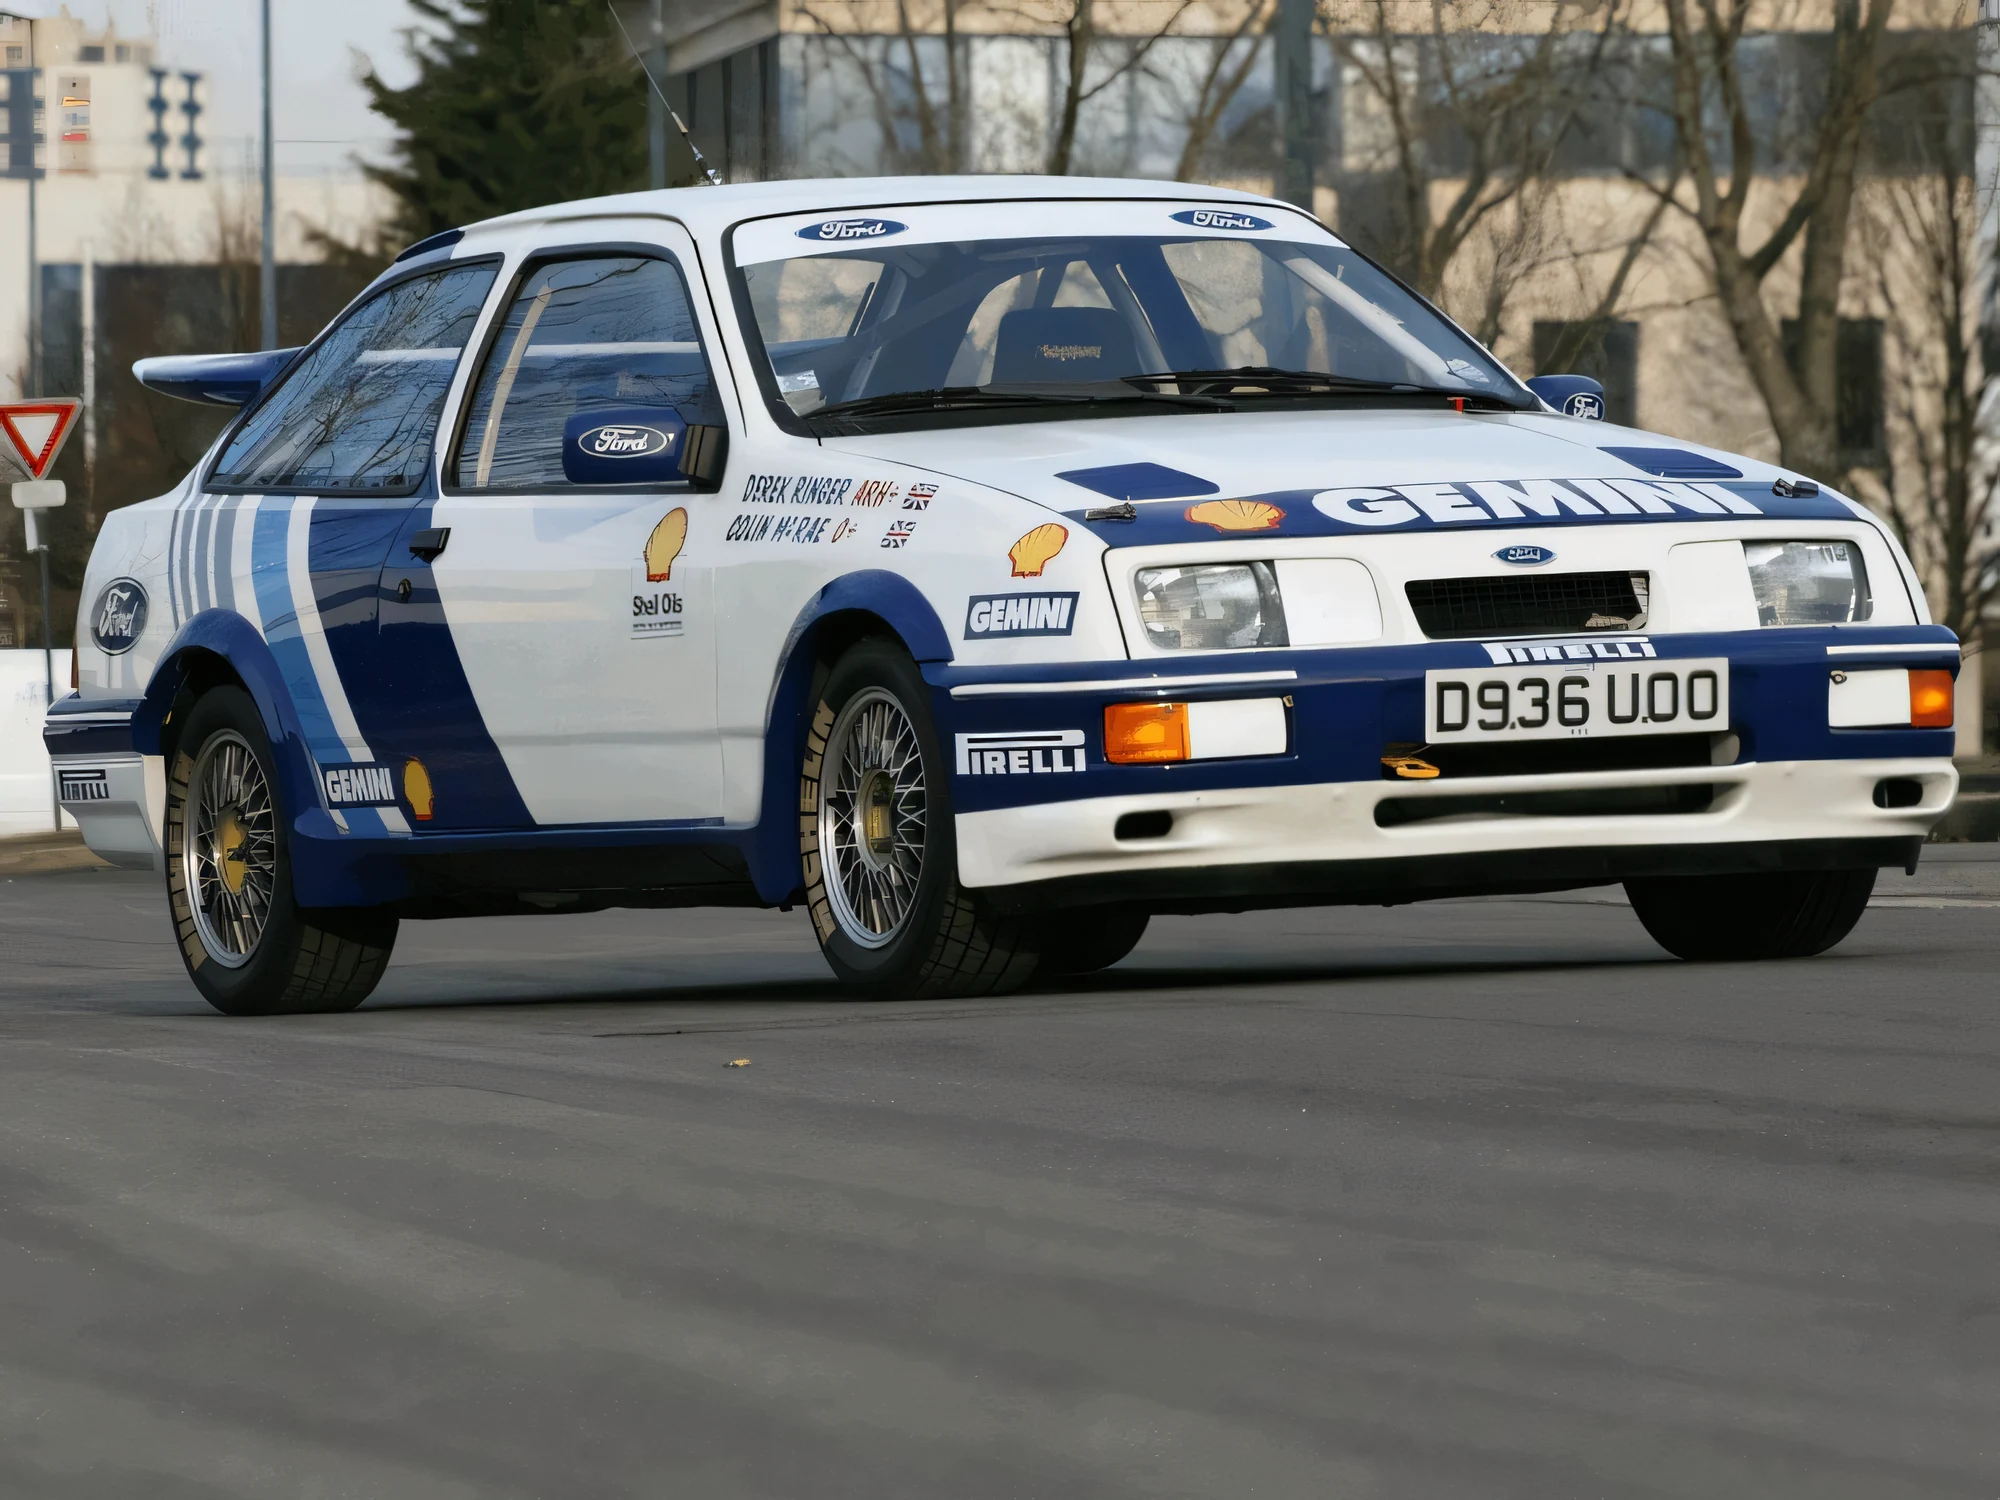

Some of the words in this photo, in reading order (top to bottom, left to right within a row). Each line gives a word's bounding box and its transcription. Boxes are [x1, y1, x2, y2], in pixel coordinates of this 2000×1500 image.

[819, 220, 886, 239] Ford
[595, 428, 648, 452] Ford
[1312, 477, 1763, 526] GEMINI
[969, 597, 1073, 633] GEMINI
[1481, 637, 1657, 664] PIRELLI
[1436, 675, 1590, 733] D936
[955, 729, 1086, 775] PIRELLI
[326, 768, 395, 802] GEMINI
